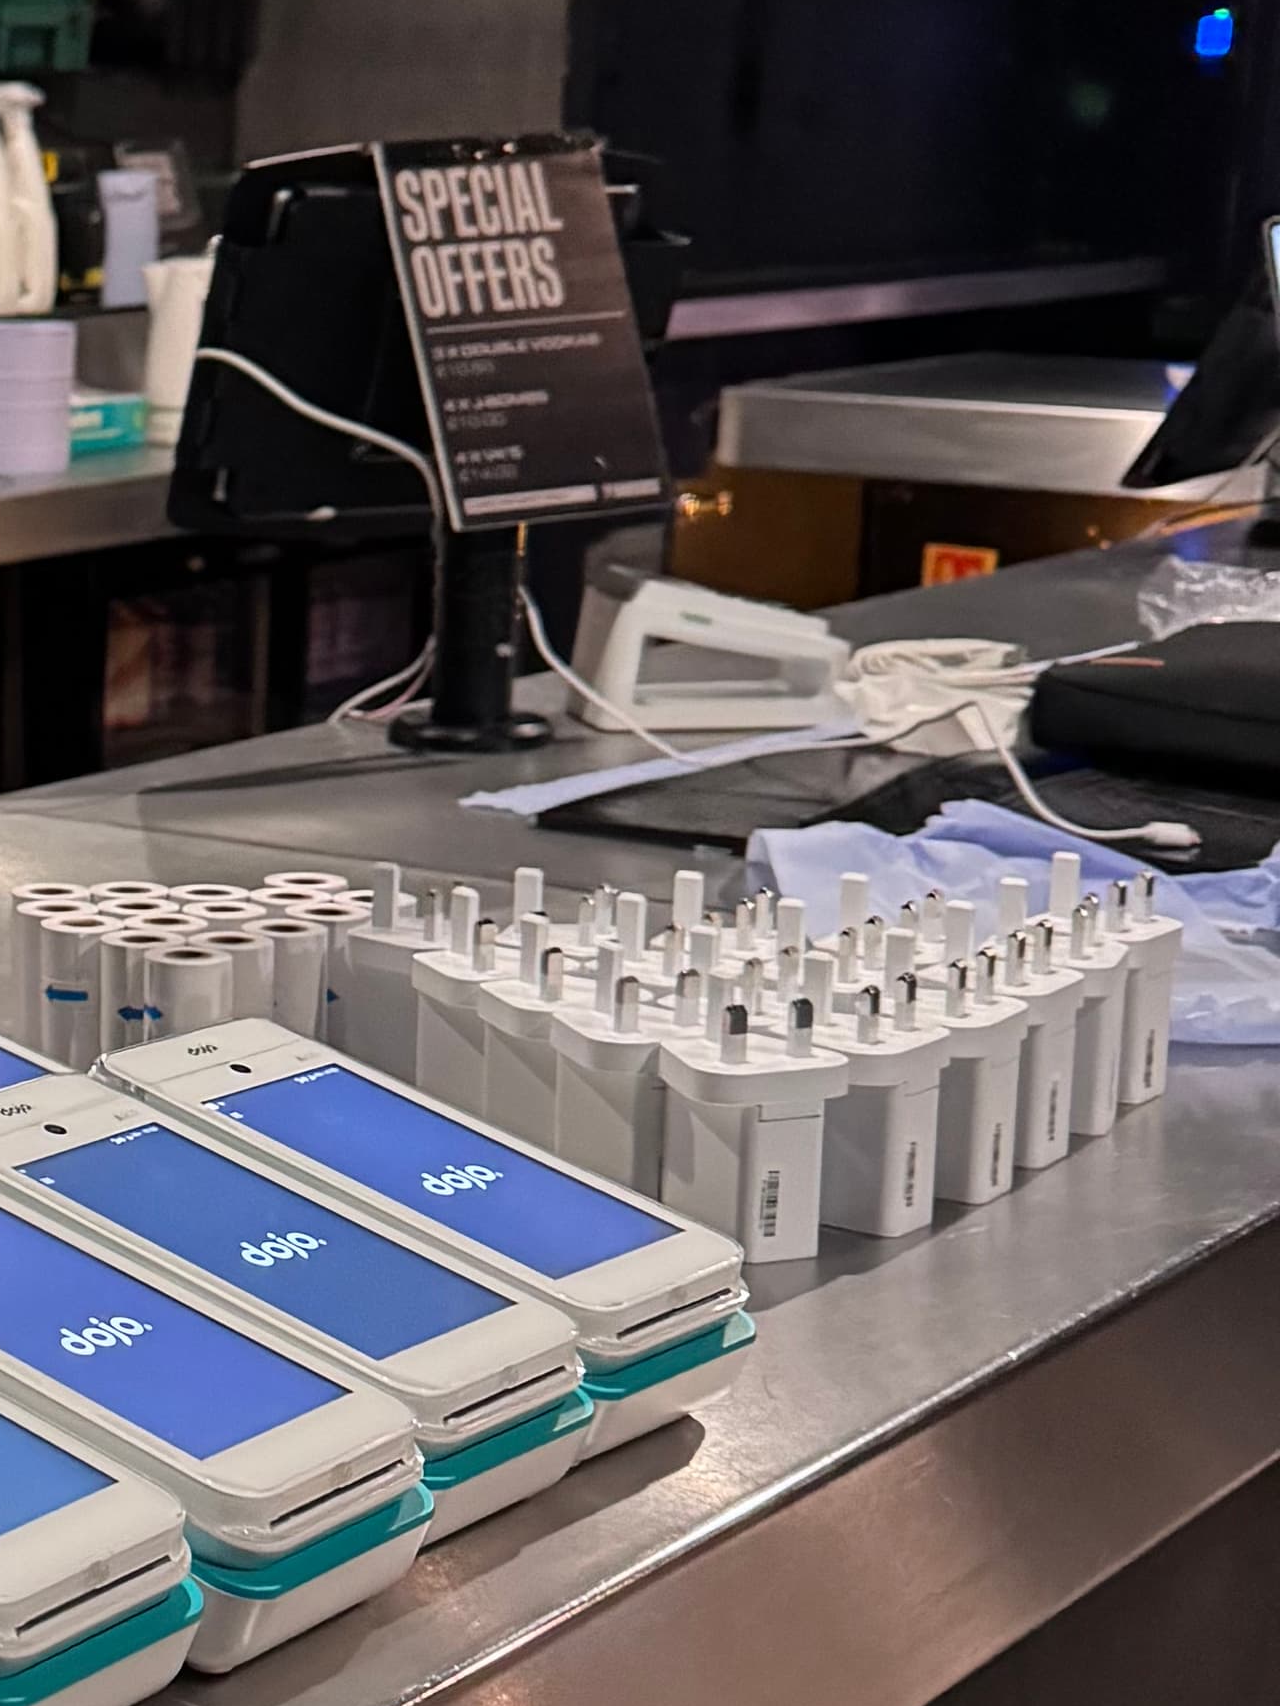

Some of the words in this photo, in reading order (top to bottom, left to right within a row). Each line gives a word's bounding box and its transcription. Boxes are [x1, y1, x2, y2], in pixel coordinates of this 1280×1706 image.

[395, 161, 565, 242] SPECIAL
[410, 236, 565, 319] OFFERS
[421, 1164, 504, 1196] dojo.
[240, 1231, 328, 1268] dojo.
[60, 1315, 154, 1356] dojo.
